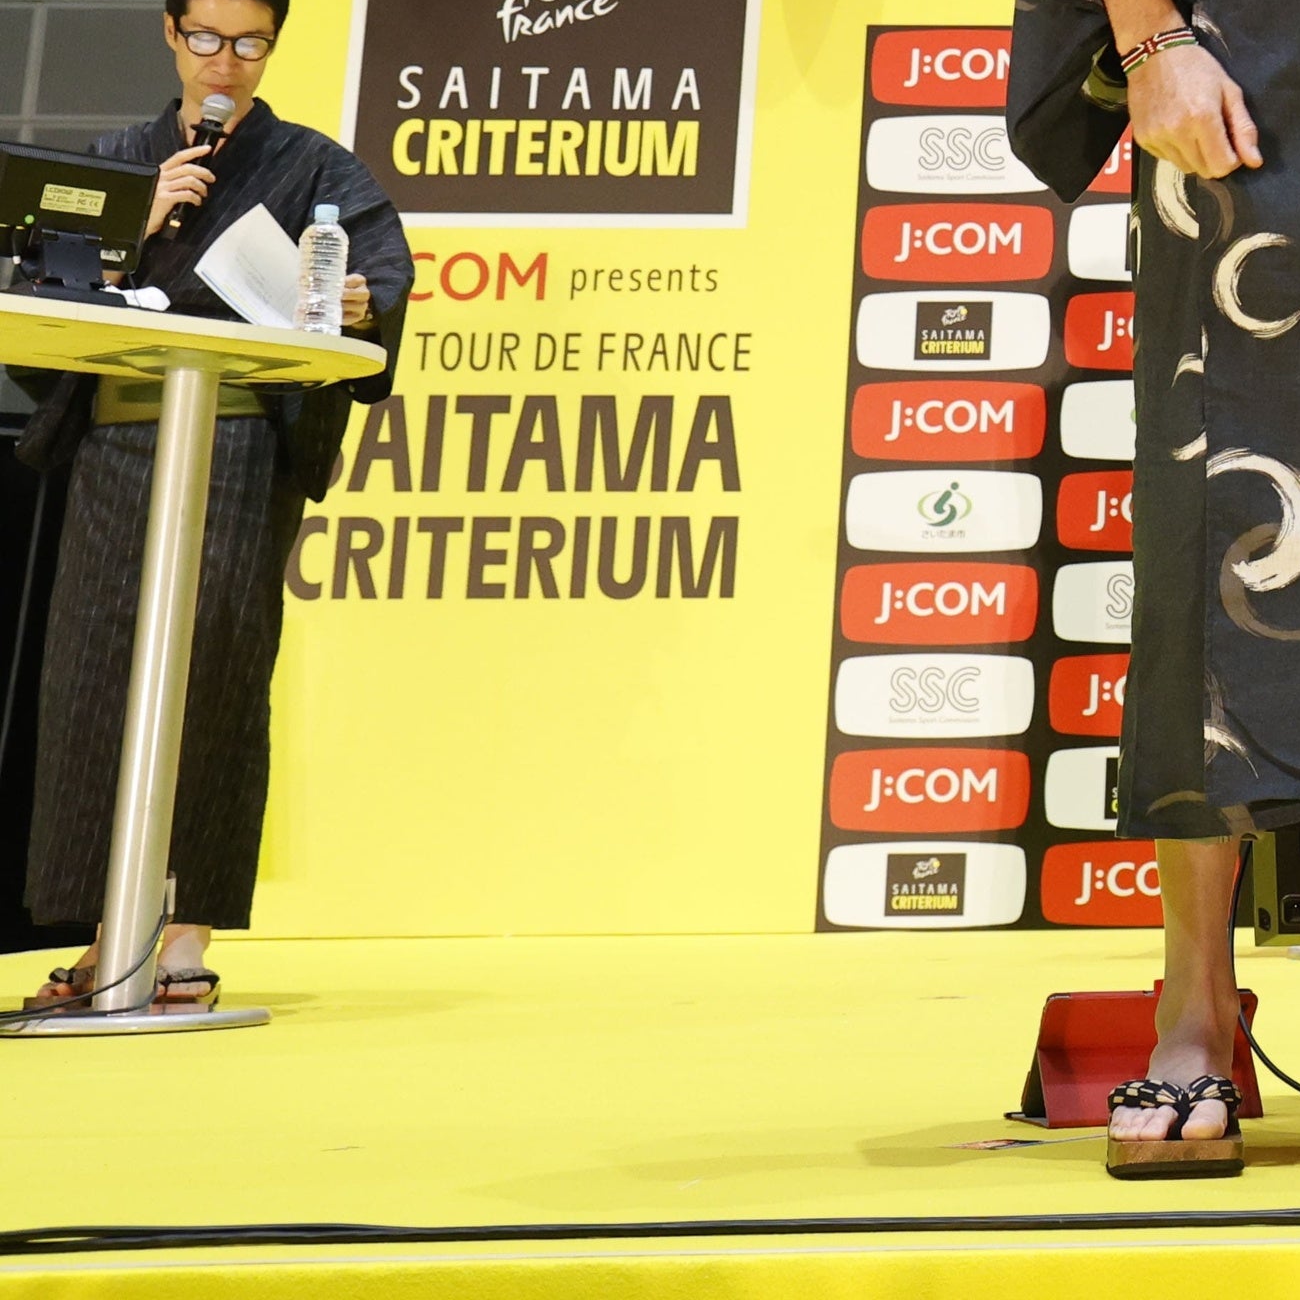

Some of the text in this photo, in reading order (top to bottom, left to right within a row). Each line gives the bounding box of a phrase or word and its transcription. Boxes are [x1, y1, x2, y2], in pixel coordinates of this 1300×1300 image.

[397, 66, 701, 110] SAITAMA
[392, 118, 700, 177] CRITERIUM
[918, 127, 1006, 171] SSC
[894, 222, 1022, 262] J:COM
[407, 252, 719, 301] COM presents
[415, 332, 753, 371] TOUR DE FRANCE
[921, 341, 985, 354] CRITERIUM
[922, 330, 984, 340] SAITAMA
[884, 400, 1014, 441] J:COM
[325, 394, 742, 493] AITAMA
[284, 515, 740, 601] CRITERIUM
[874, 582, 1006, 624] J:COM
[889, 666, 981, 713] SSC
[864, 767, 997, 811] J:COM
[891, 895, 958, 910] CRITERIUM
[892, 883, 958, 895] SAITAMA
[1075, 861, 1161, 906] J:CO
